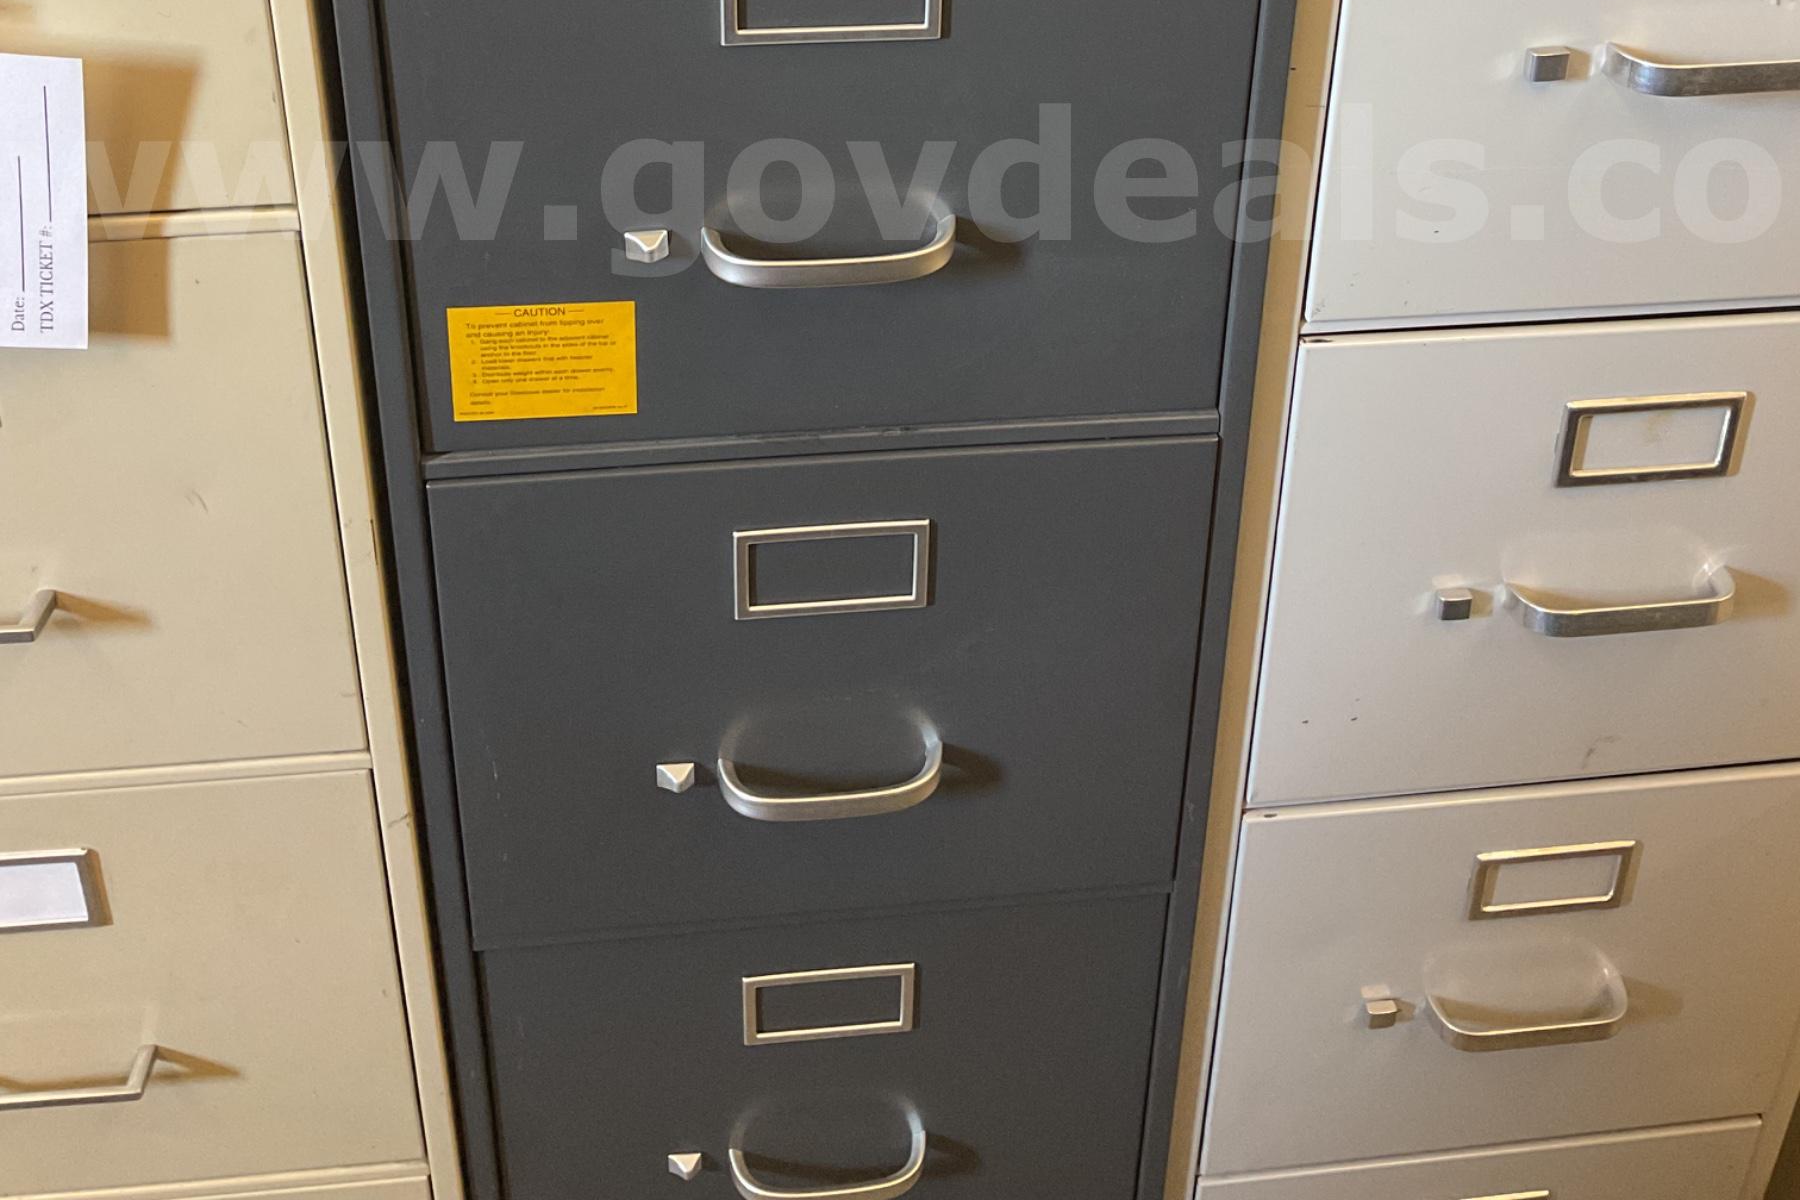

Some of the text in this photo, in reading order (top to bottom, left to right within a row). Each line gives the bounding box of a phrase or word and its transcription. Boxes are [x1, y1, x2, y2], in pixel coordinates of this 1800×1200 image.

[39, 240, 54, 297] TICKET
[11, 297, 24, 331] Date:
[40, 301, 54, 334] TDX
[513, 307, 566, 317] CAUTION
